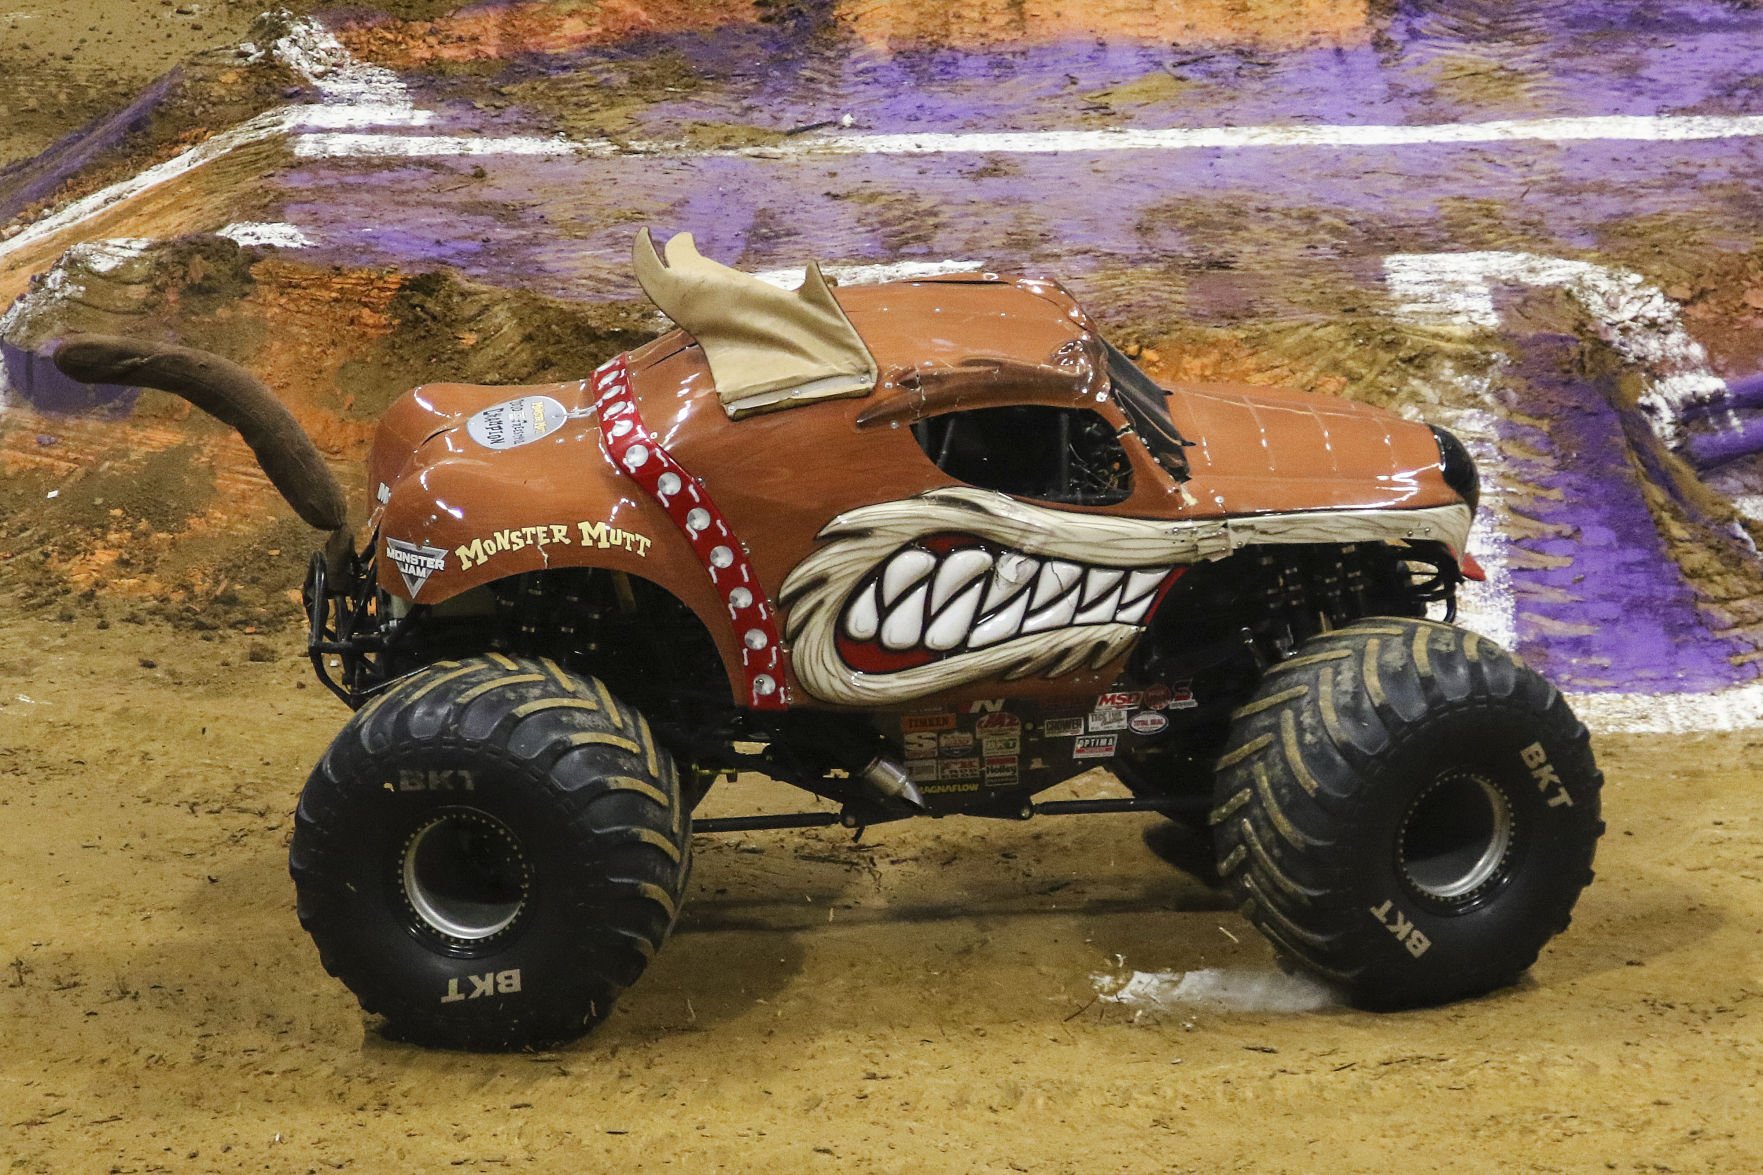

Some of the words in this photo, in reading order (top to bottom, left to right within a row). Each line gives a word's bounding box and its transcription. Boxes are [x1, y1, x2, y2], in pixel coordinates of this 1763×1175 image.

[483, 407, 506, 445] CHAMPION
[454, 524, 572, 572] MONSTER
[577, 520, 651, 558] MUTT
[386, 548, 445, 571] MONSTER
[400, 564, 427, 578] JAM
[1098, 693, 1140, 707] MSD
[1133, 719, 1149, 727] TOTAL
[1078, 738, 1115, 748] OPTIMA
[399, 769, 480, 791] BKT
[986, 765, 1017, 778] Holley
[1519, 741, 1575, 808] BKT
[1369, 899, 1432, 959] BKT
[440, 968, 522, 1004] BKT
